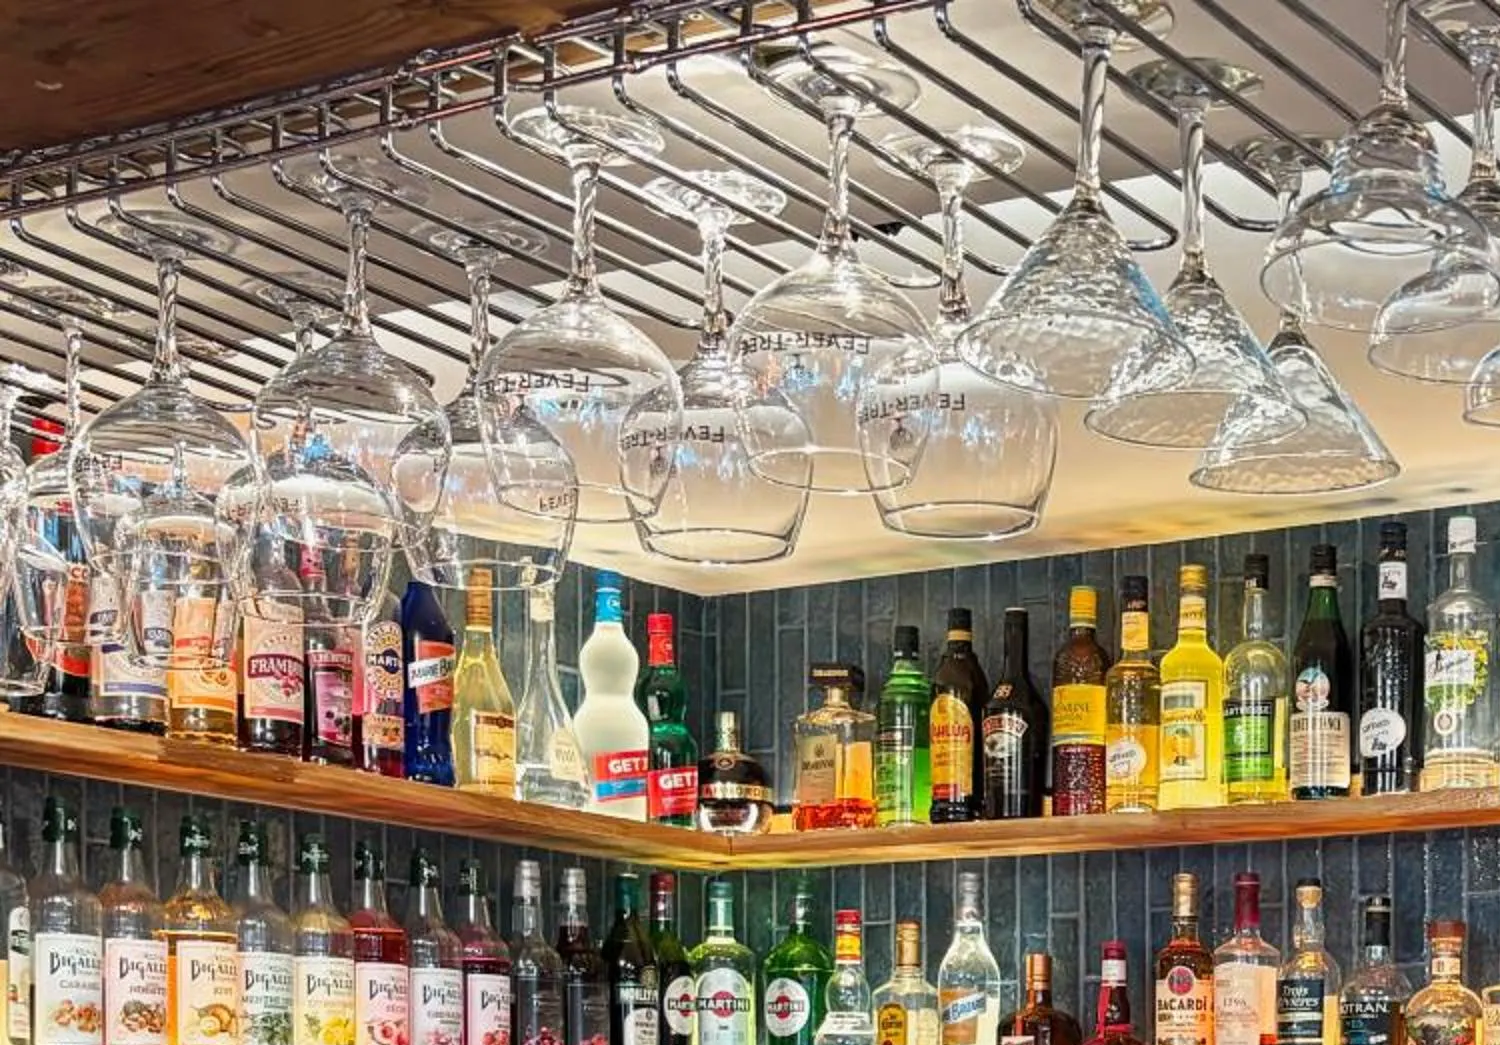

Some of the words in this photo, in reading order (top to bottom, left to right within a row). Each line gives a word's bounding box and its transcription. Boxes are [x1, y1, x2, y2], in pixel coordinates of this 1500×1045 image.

[608, 757, 642, 774] GET
[658, 773, 692, 789] GET
[698, 998, 751, 1012] MARTINI
[766, 1000, 806, 1014] MARTINI
